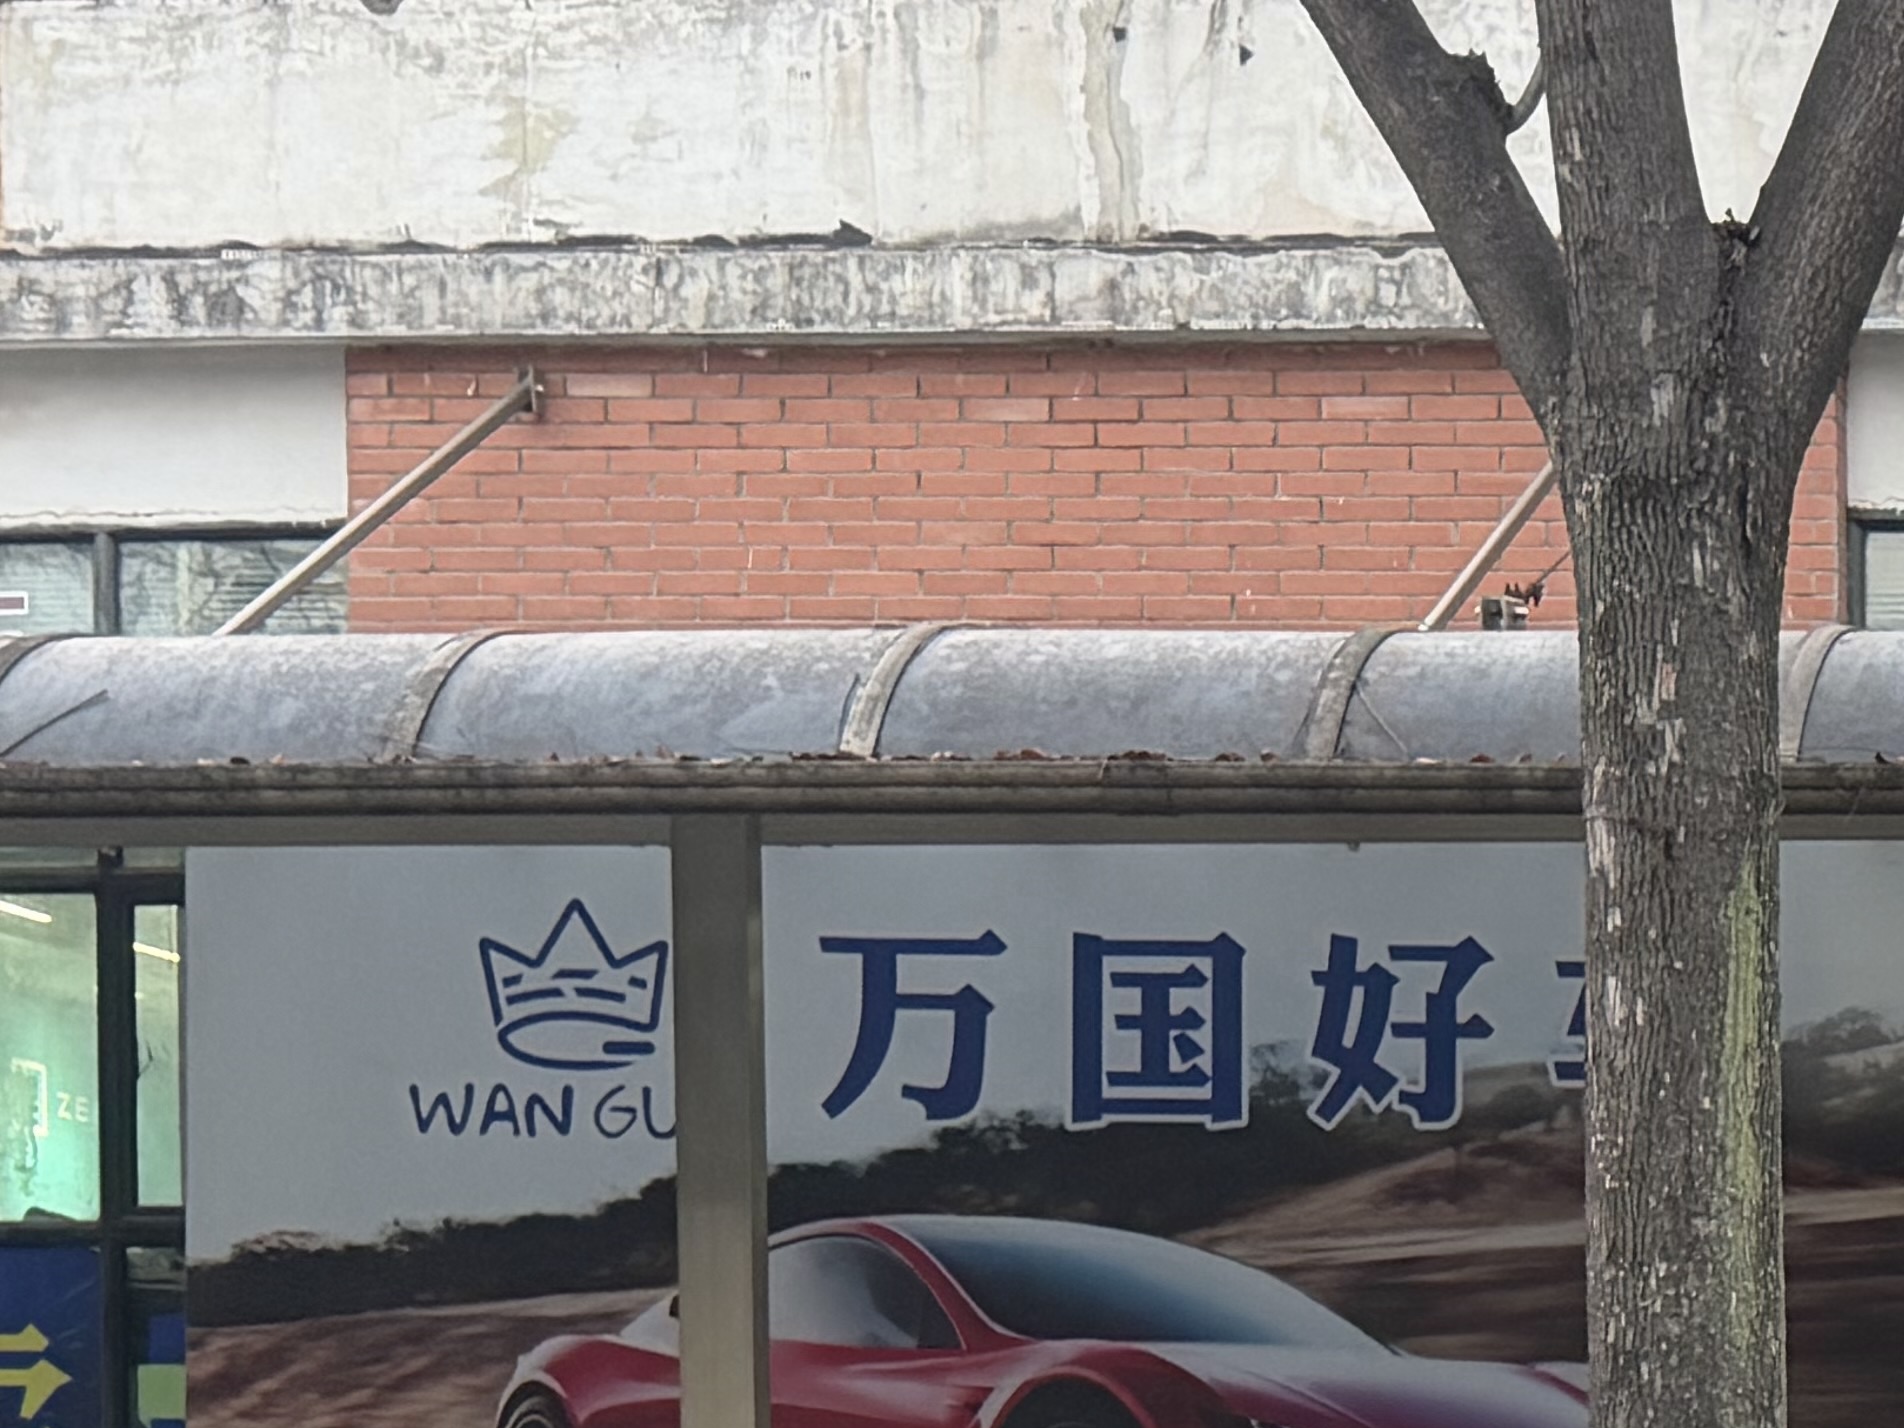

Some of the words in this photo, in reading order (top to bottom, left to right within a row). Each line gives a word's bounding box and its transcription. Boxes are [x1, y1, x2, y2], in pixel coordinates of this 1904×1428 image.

[818, 928, 1586, 1128] 万国好
[409, 1083, 574, 1137] WAN
